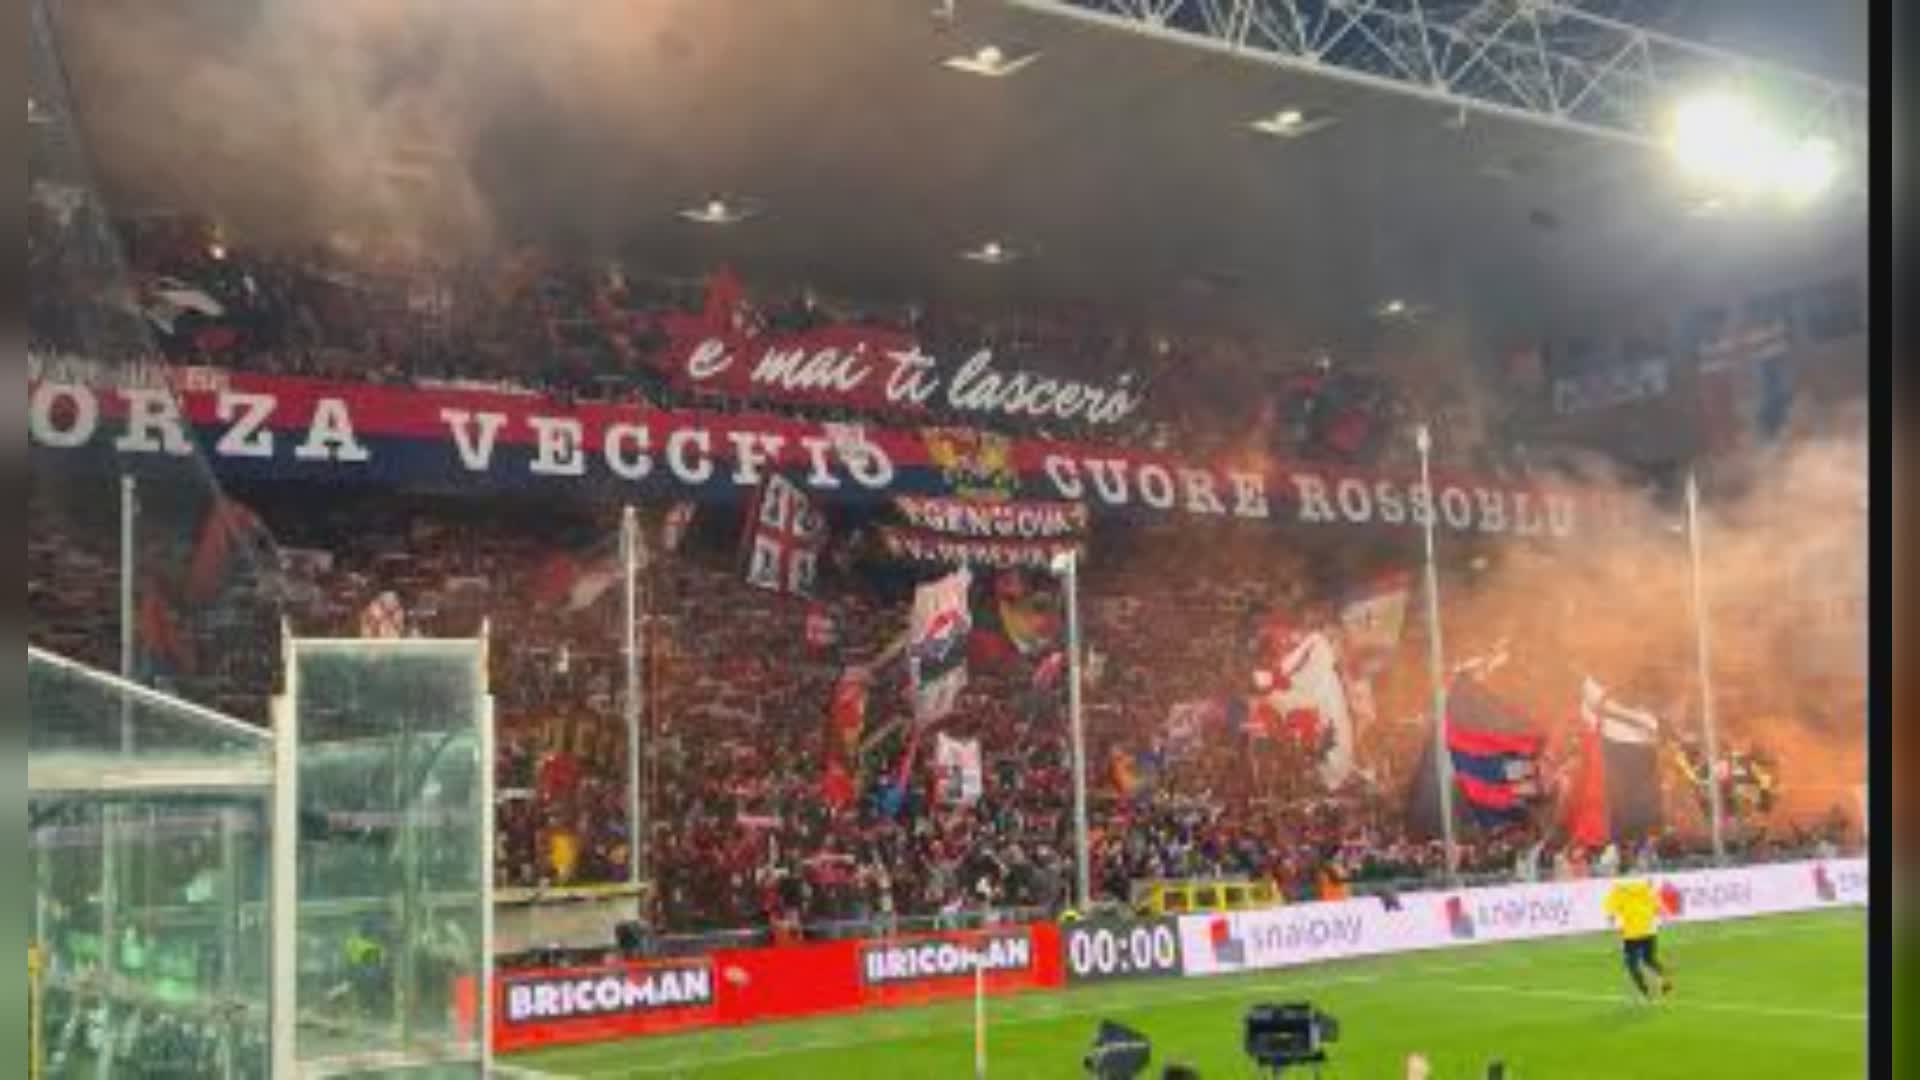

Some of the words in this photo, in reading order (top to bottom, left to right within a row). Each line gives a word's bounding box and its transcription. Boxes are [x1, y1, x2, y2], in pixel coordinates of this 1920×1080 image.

[688, 340, 733, 378] e
[751, 341, 871, 391] mai
[885, 347, 940, 401] ti
[1045, 455, 1269, 517] CUORE
[866, 938, 1029, 981] BRICOMAN
[1069, 925, 1174, 974] 00:00
[509, 969, 709, 1020] BRICOMAN
